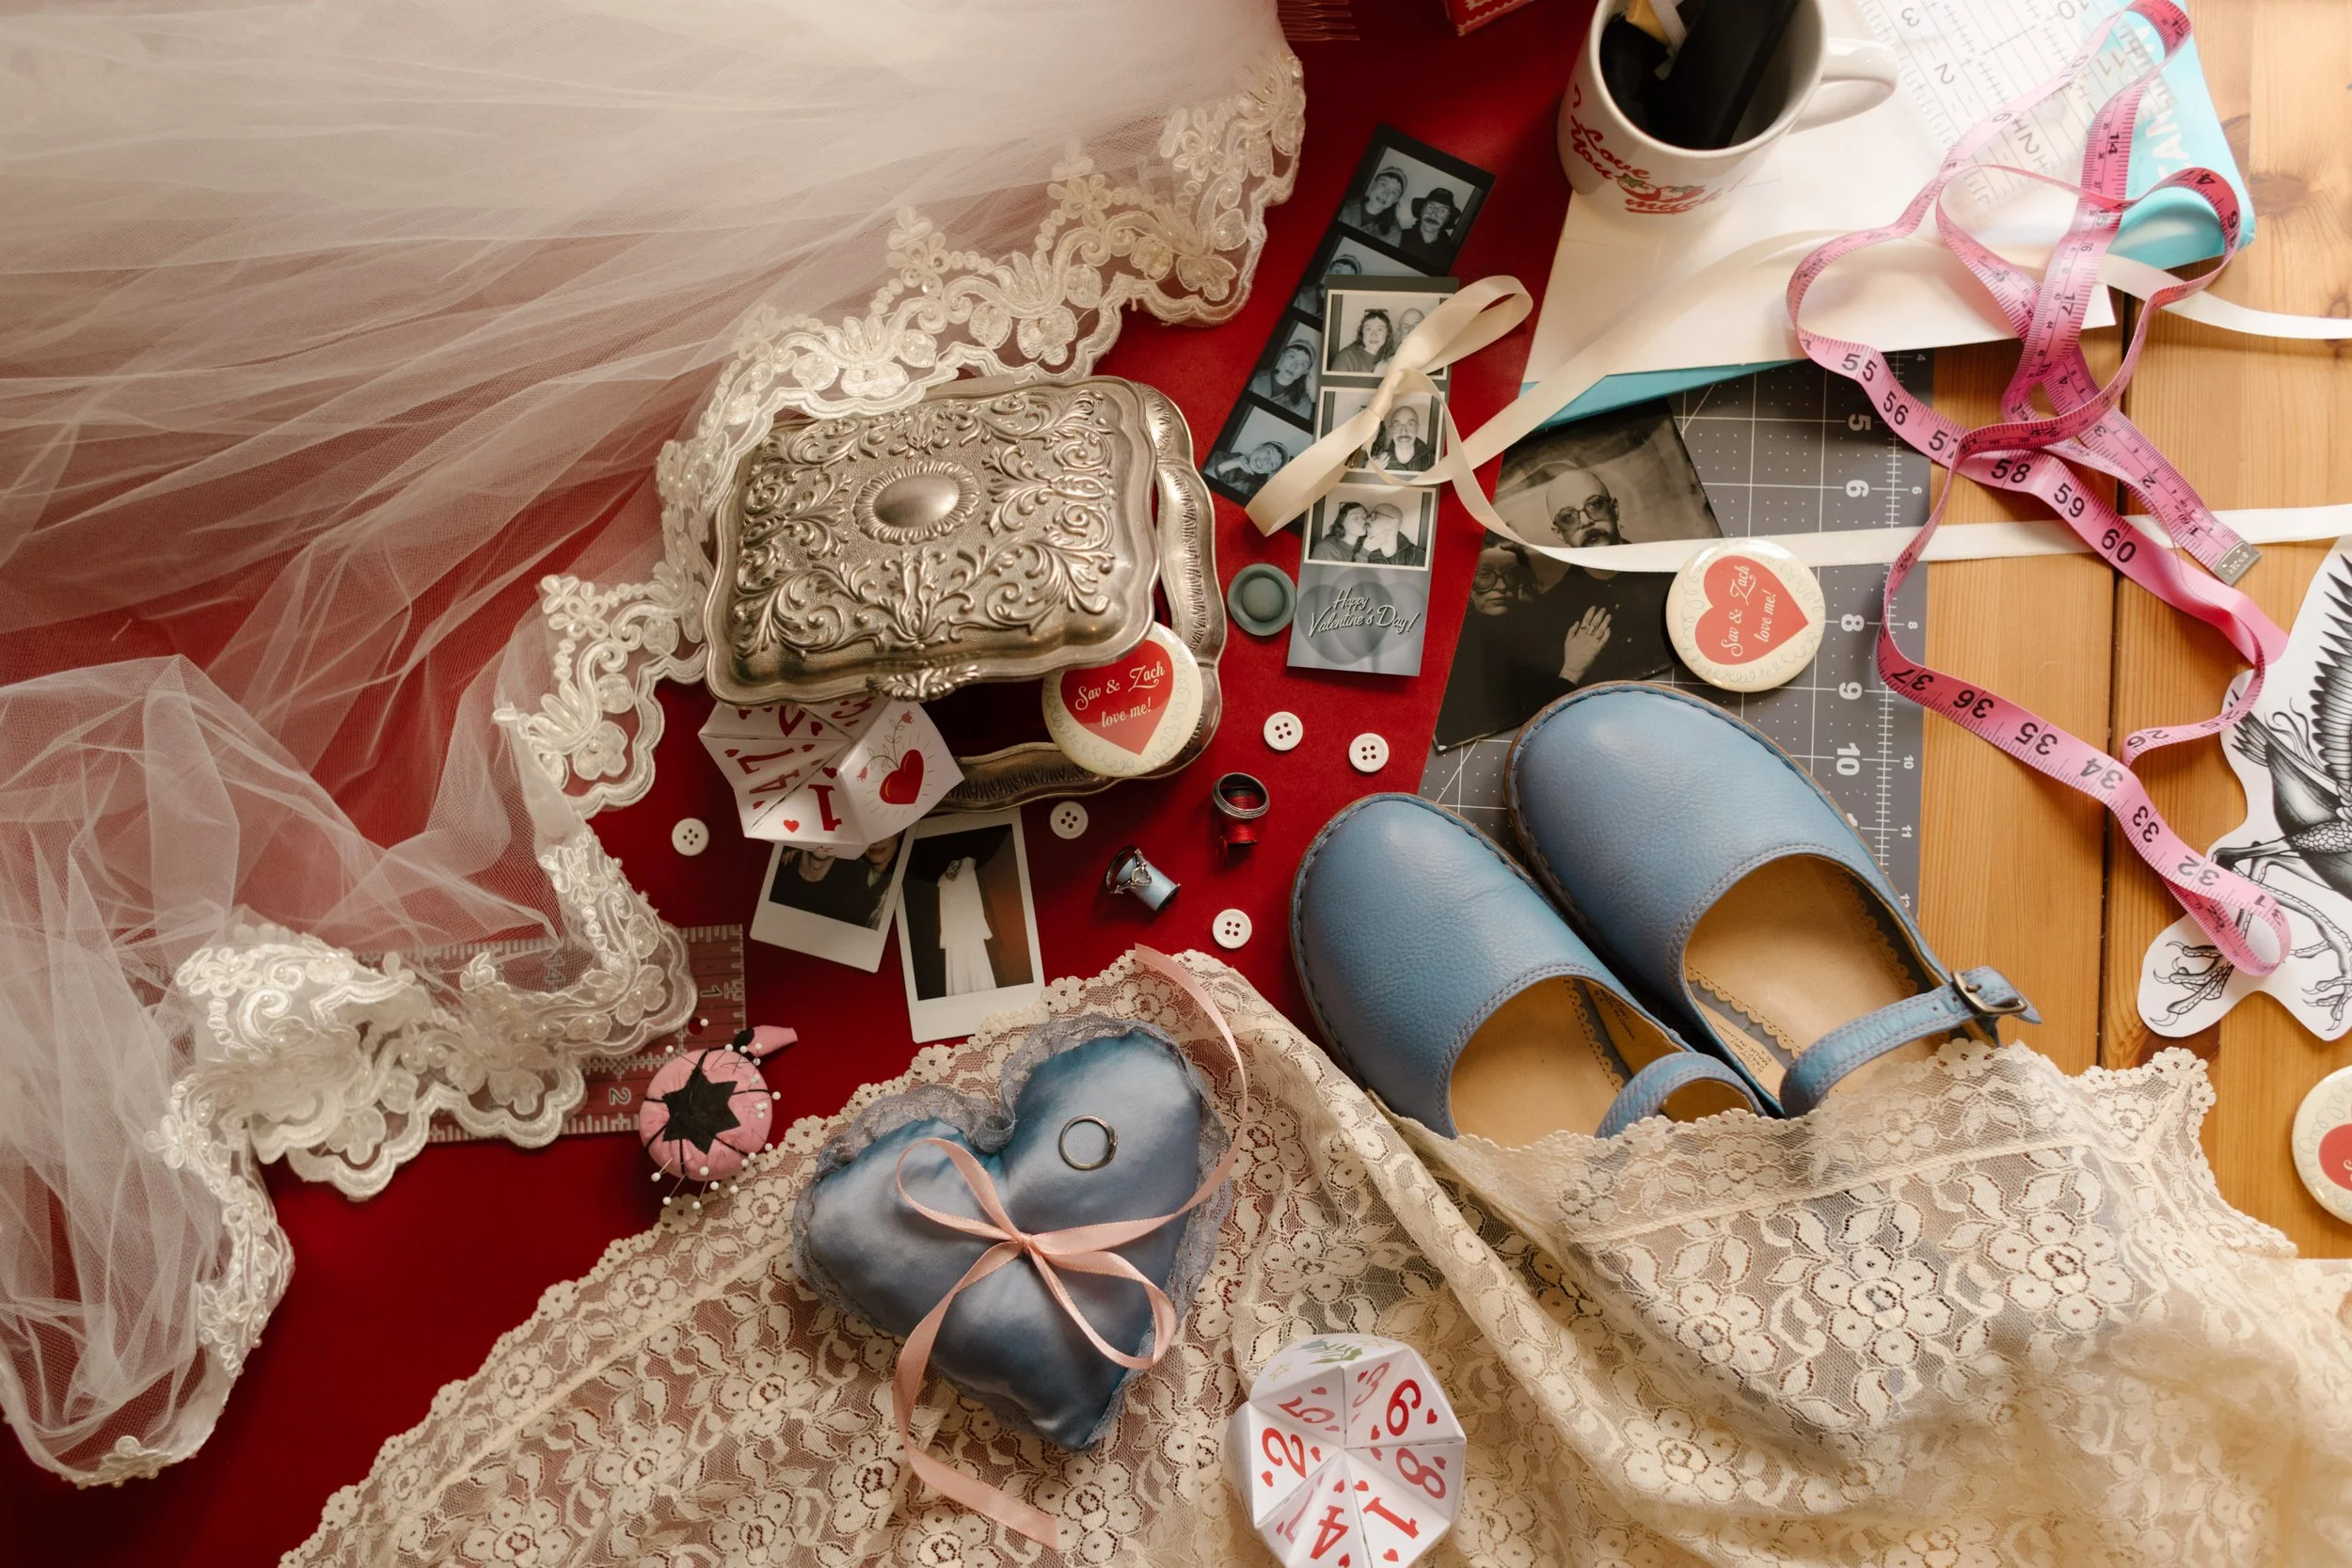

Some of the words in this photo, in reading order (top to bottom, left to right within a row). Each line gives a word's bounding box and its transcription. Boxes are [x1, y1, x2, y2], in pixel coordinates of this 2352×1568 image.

[1900, 8, 1920, 27] 3
[1934, 63, 1955, 85] 2
[2096, 51, 2125, 75] 11
[2107, 131, 2120, 155] 14
[2061, 293, 2076, 317] 17
[1841, 353, 1878, 383] 55
[2058, 376, 2069, 386] 4
[1883, 390, 1909, 426] 56
[1848, 413, 1872, 432] 5
[2093, 425, 2106, 438] 3
[1990, 457, 2031, 484] 58
[2142, 475, 2156, 489] 2
[1845, 479, 1869, 499] 6
[1912, 485, 1922, 496] 6
[2053, 482, 2087, 519] 59
[2101, 529, 2137, 563] 60
[1729, 564, 1756, 606] Zach
[1333, 587, 1370, 611] Happy
[1762, 589, 1777, 615] me!
[1309, 605, 1375, 639] Valentine's
[1376, 604, 1422, 635] Day!
[1728, 609, 1742, 625] &
[1754, 616, 1772, 643] love
[1840, 613, 1865, 632] 8
[1908, 621, 1918, 630] 8
[1720, 626, 1743, 657] Sav
[1074, 686, 1102, 711] Sav
[1105, 679, 1120, 694] &
[1128, 660, 1166, 692] Zach
[1838, 681, 1863, 700] 9
[1891, 669, 1934, 692] 37
[1102, 710, 1126, 728] love
[1130, 696, 1152, 720] me!
[1953, 689, 1994, 720] 36
[2200, 709, 2241, 731] 25
[2015, 721, 2058, 756] 35
[2126, 729, 2169, 750] 26
[1836, 742, 1861, 776] 10
[1903, 754, 1915, 769] 10
[749, 768, 800, 795] 4
[2079, 757, 2123, 791] 34
[808, 784, 843, 832] 1
[1901, 824, 1913, 839] 11
[2132, 805, 2160, 844] 33
[2177, 855, 2221, 887] 32
[2254, 894, 2286, 927] 31
[699, 984, 723, 998] 1
[609, 1087, 632, 1105] 2
[1353, 1361, 1391, 1408] 3
[1278, 1396, 1335, 1424] 5
[1386, 1379, 1422, 1436] 6
[1262, 1427, 1307, 1480] 2
[1396, 1448, 1446, 1499] 8
[1310, 1504, 1349, 1560] 4
[1362, 1497, 1420, 1540] 1
